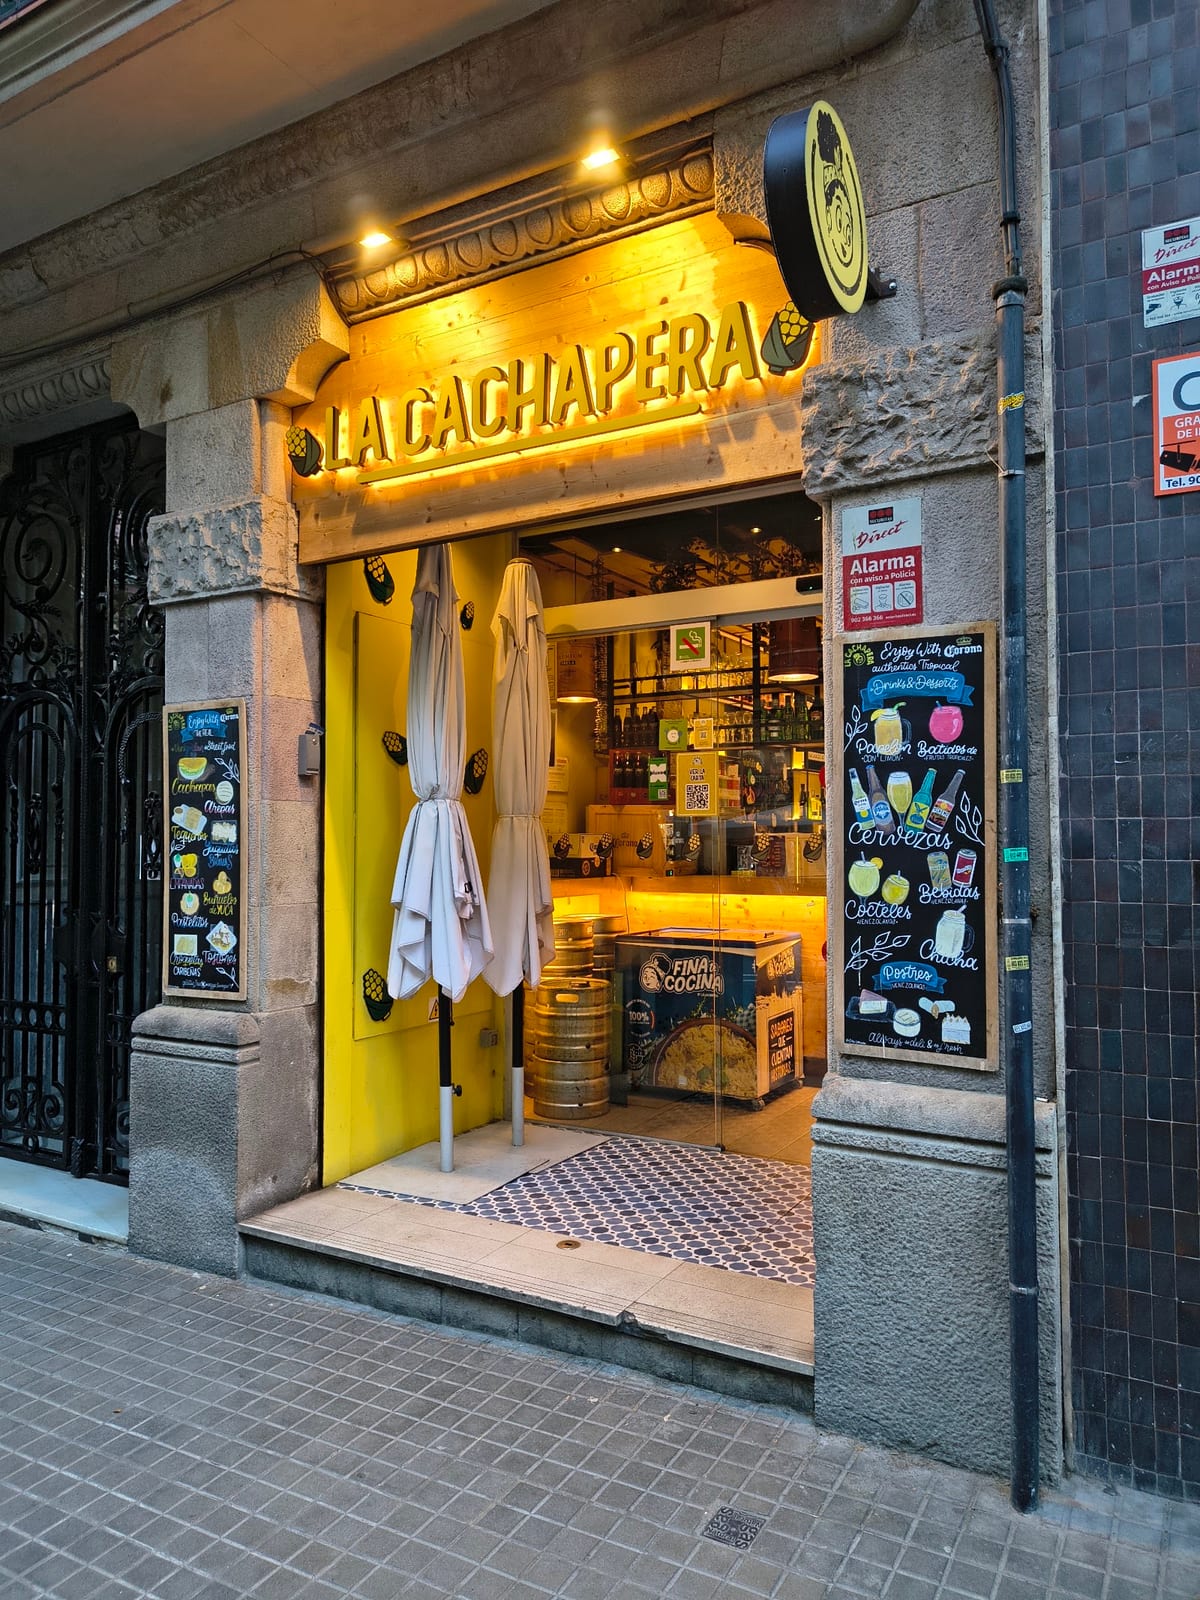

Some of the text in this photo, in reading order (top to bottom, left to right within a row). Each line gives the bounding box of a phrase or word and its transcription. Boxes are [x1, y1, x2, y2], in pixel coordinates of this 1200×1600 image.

[324, 300, 761, 472] LA CACHAPERA
[1177, 428, 1193, 439] DE
[1165, 477, 1186, 488] Tel.
[856, 520, 908, 549] Direct
[850, 554, 915, 576] Alarma
[850, 577, 863, 585] con
[864, 574, 883, 583] aviso
[880, 641, 983, 663] Enjoy With Corona
[917, 740, 966, 758] Batidos
[966, 746, 978, 755] de
[848, 821, 953, 850] Cervezas
[918, 882, 981, 905] Bebidas
[845, 898, 912, 920] Cocteles
[919, 938, 979, 971] Chicha
[673, 957, 708, 976] FINA
[882, 964, 933, 983] Postres
[664, 973, 723, 993] COCINA
[628, 1010, 650, 1021] 100%
